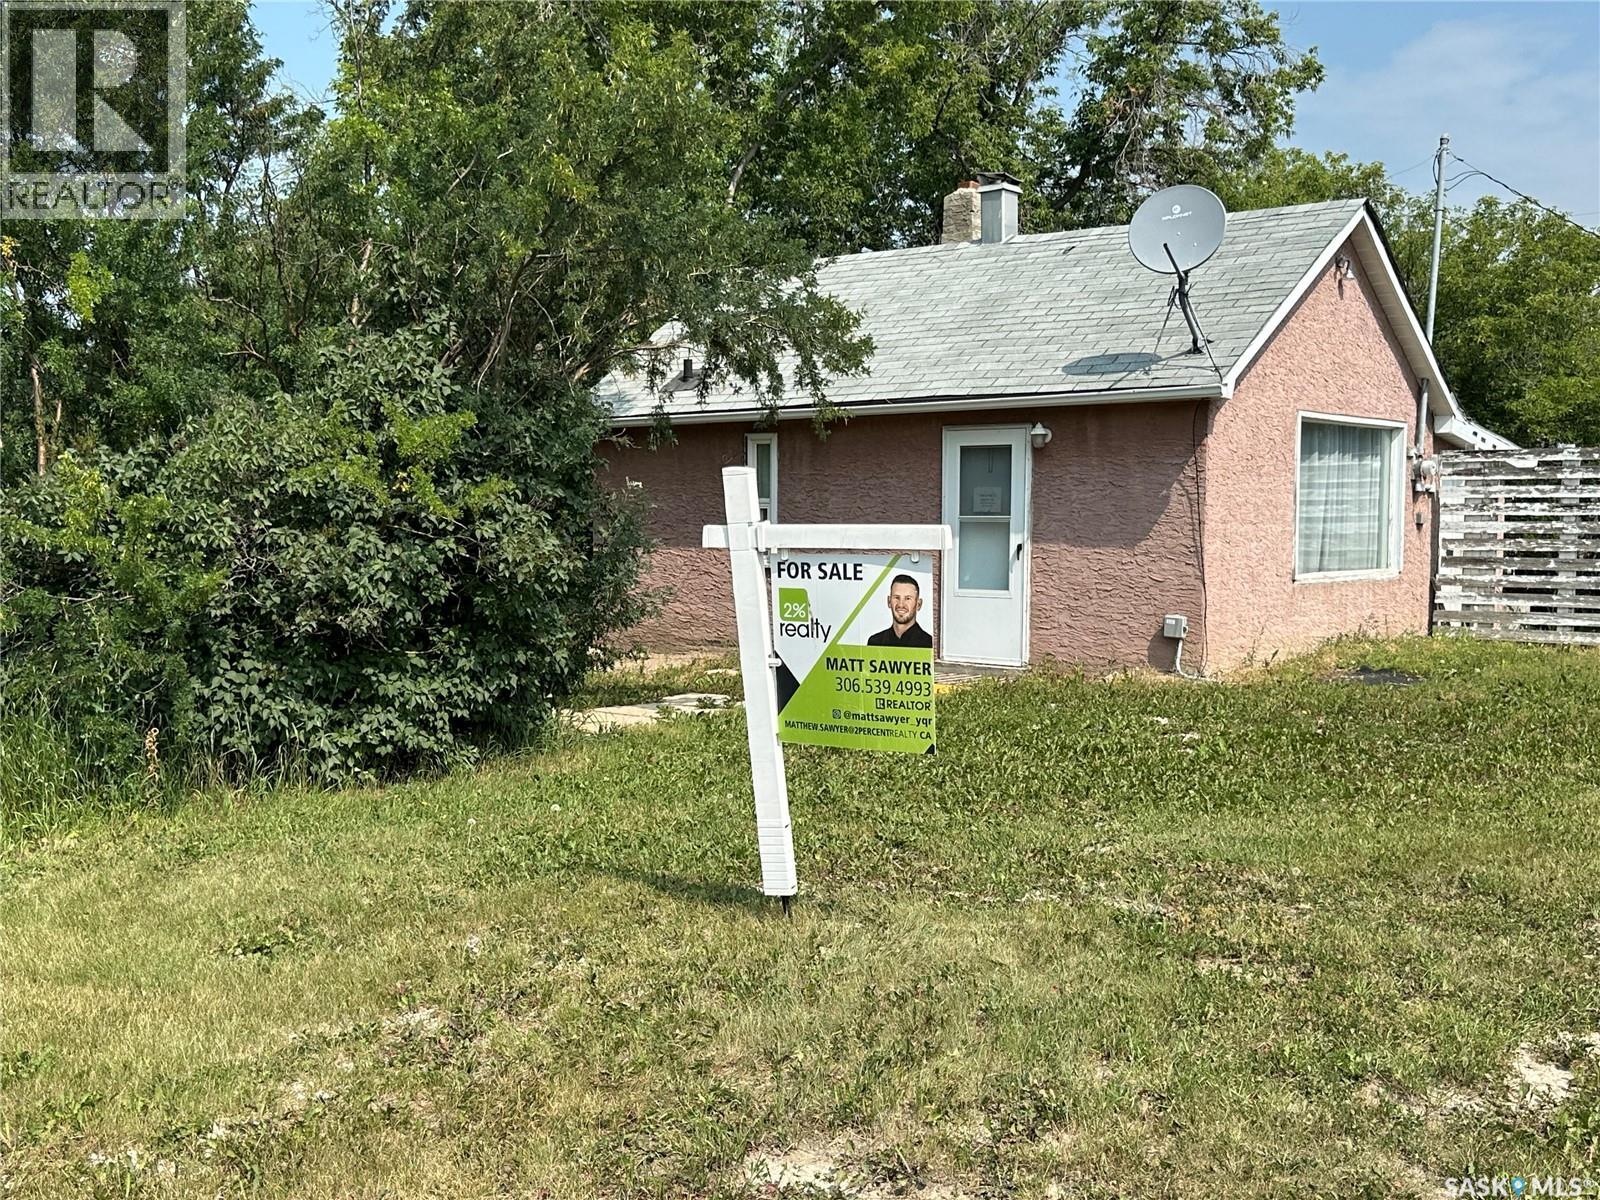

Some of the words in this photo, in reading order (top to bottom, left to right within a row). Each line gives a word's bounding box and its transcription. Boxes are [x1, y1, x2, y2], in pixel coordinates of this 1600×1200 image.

[777, 561, 812, 579] FOR
[817, 562, 864, 581] SALE
[783, 602, 806, 618] 2%
[779, 617, 832, 643] realty
[826, 657, 865, 672] MATT
[869, 659, 932, 676] SAWYER
[835, 676, 931, 697] 306.539.4993
[886, 699, 931, 711] REALTOR
[843, 710, 932, 727] @mattsawyer_yqr
[784, 719, 932, 740] MATTHEW.SAWYER@2PERCENTREALTYCA
